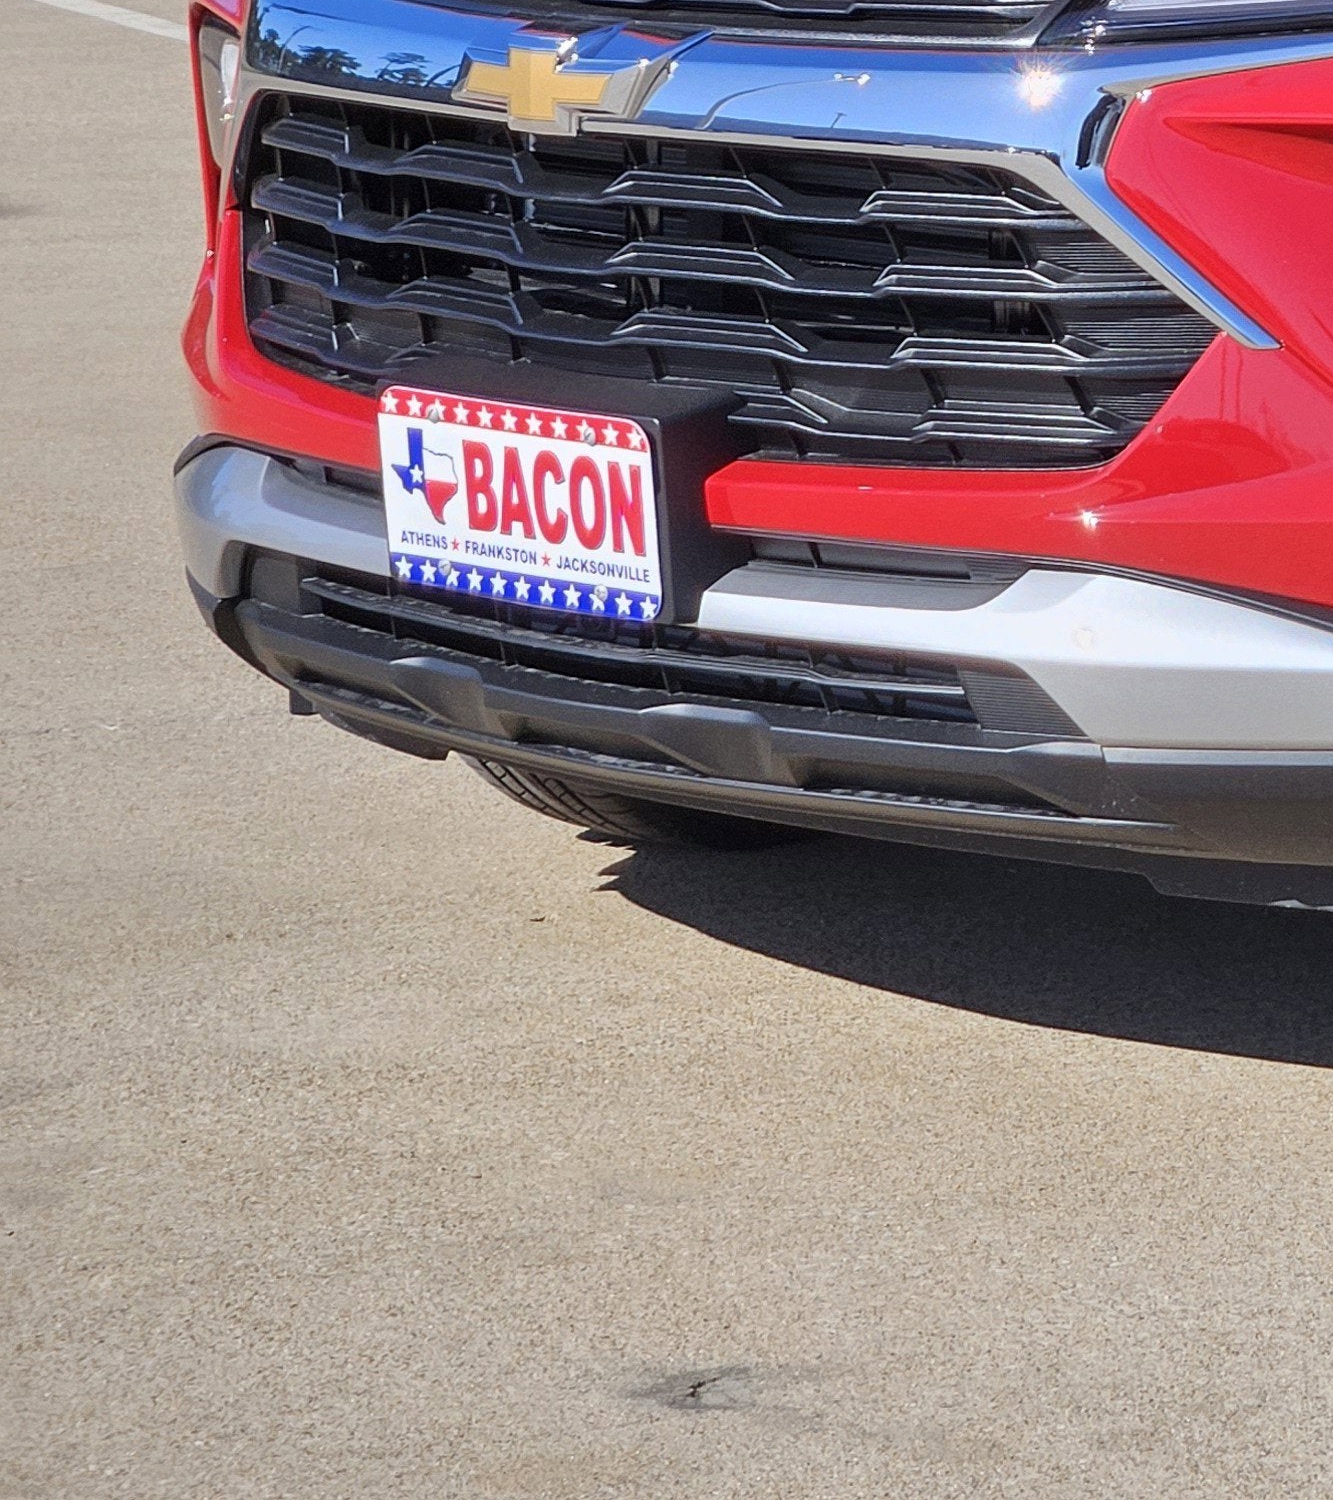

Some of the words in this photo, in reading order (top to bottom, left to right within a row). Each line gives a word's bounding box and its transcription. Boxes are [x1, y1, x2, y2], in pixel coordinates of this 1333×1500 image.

[462, 440, 647, 557] BACON
[401, 530, 448, 550] ATHENS
[465, 540, 537, 565] FRANKSTON
[556, 555, 650, 583] JACKSONVILLE
